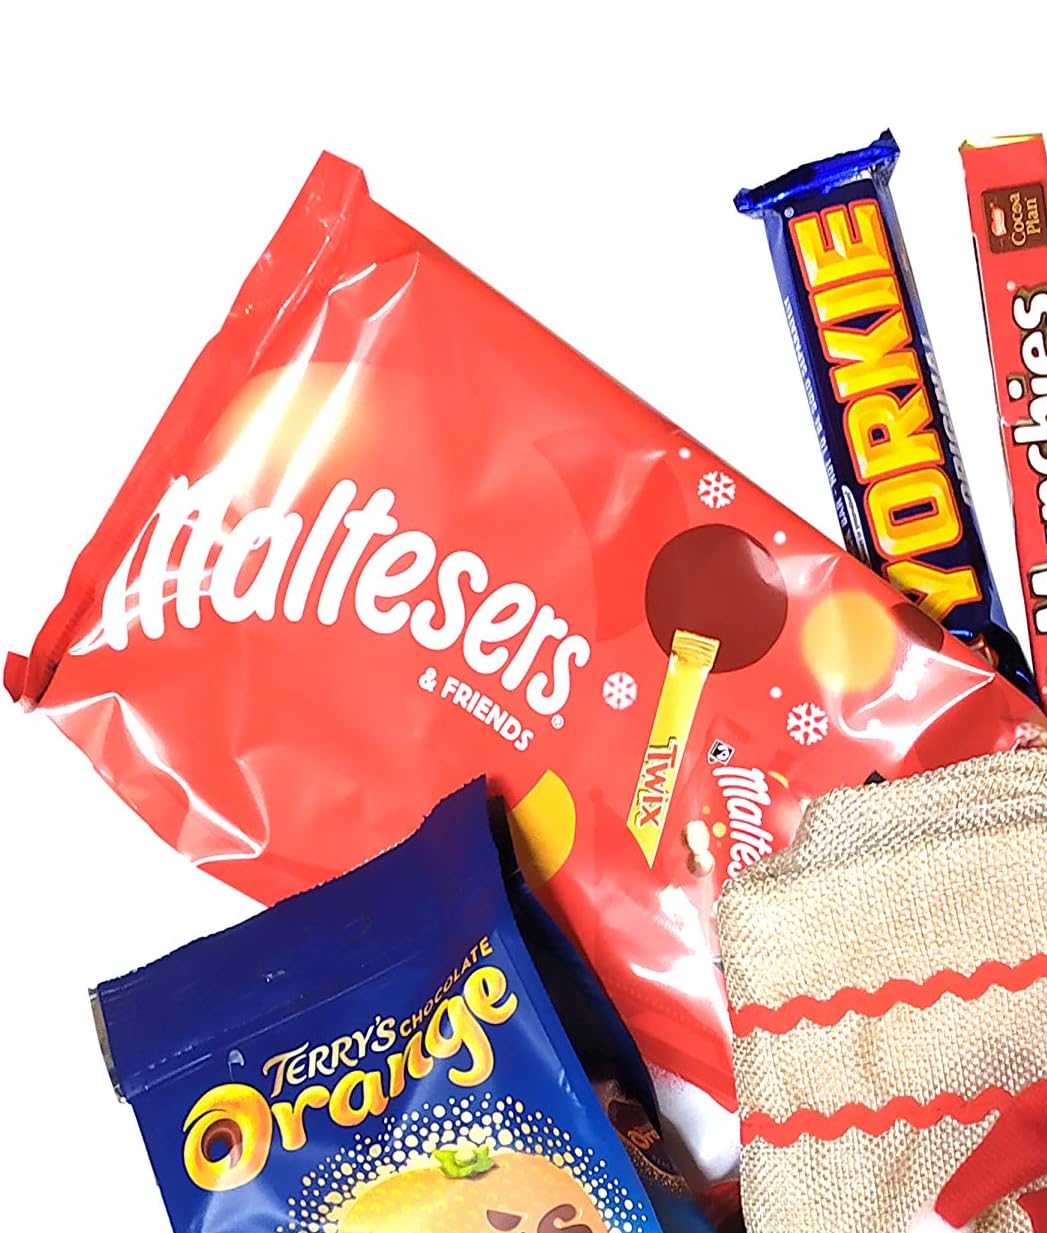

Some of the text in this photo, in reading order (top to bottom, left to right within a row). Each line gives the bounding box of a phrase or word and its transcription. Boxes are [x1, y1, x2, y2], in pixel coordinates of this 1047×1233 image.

[1010, 191, 1026, 247] Cocoa
[1025, 196, 1041, 236] Plan
[789, 197, 983, 624] YORKIE
[70, 474, 592, 716] Maltesers
[417, 666, 534, 752] & FRIENDS
[640, 742, 679, 827] TWIX
[399, 936, 494, 1038] CHOCOLATE
[182, 965, 519, 1192] Orange
[262, 1015, 397, 1098] TERRY'S
